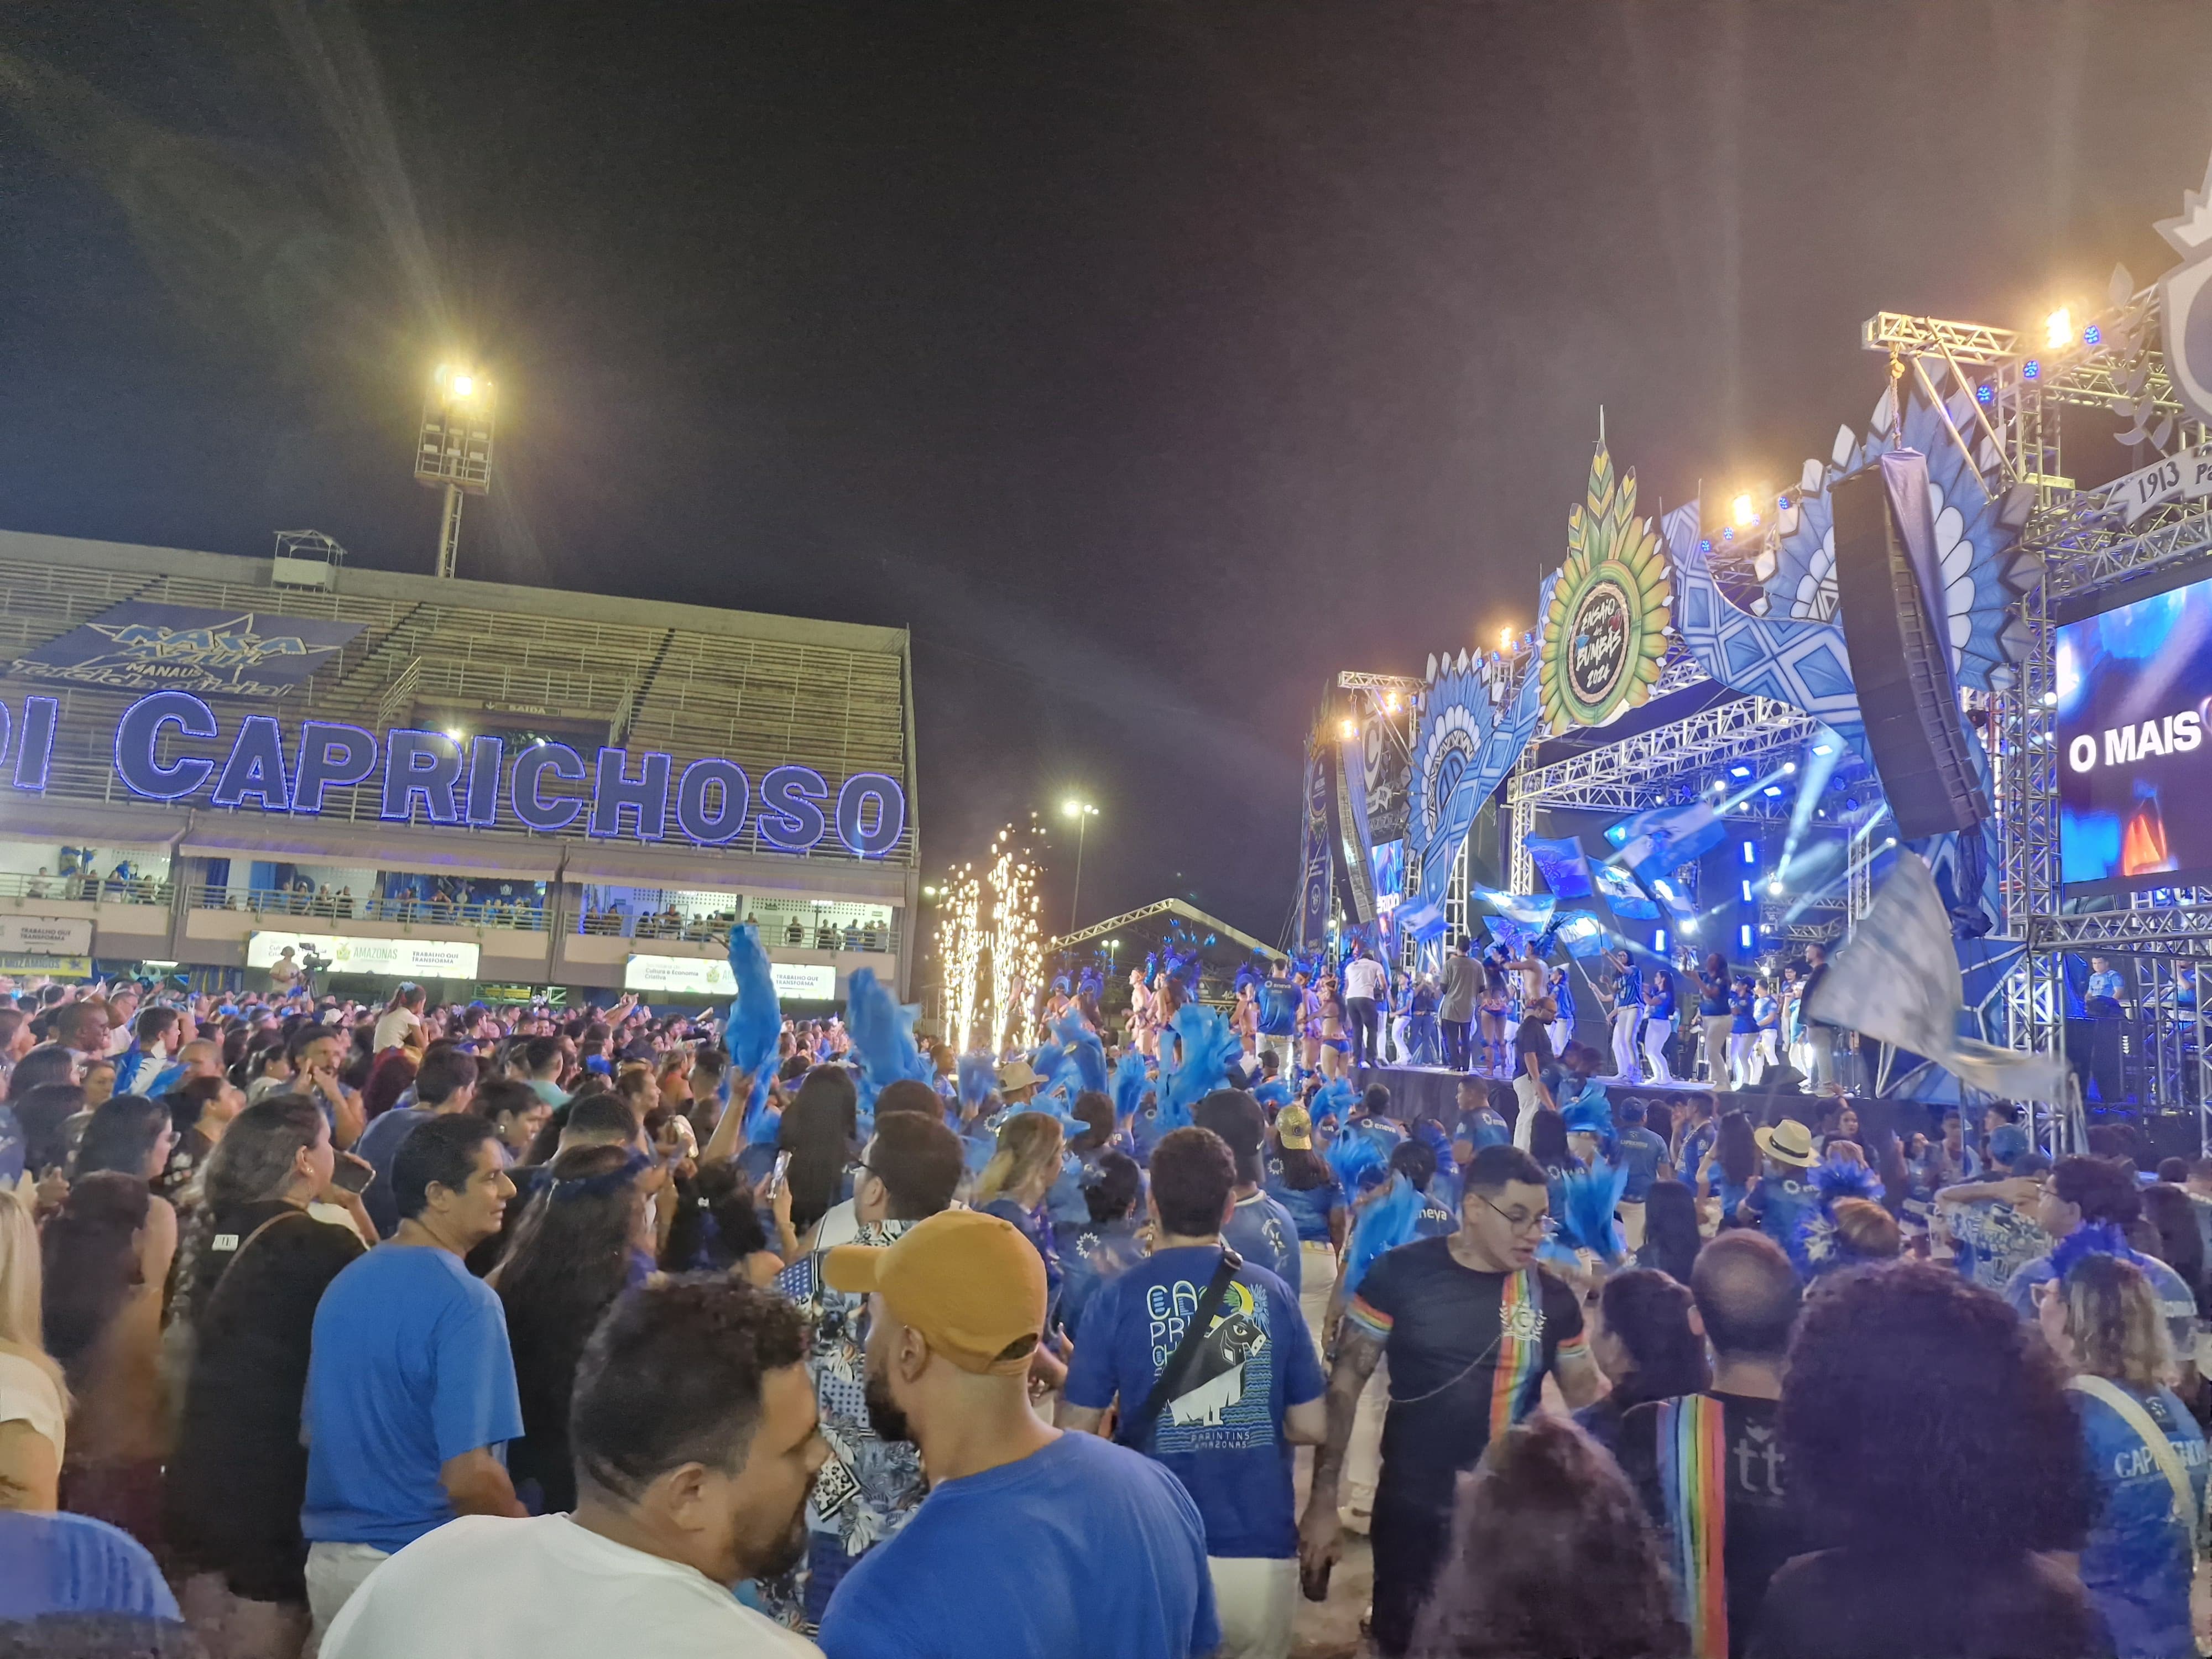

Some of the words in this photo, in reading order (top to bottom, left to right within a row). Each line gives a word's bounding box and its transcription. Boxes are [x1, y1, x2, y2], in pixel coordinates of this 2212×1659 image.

[2138, 461, 2180, 504] 1913
[126, 663, 202, 678] MANAUS
[1587, 664, 1610, 688] 2024
[2069, 734, 2096, 773] O
[2104, 711, 2202, 766] MAIS
[114, 690, 906, 855] CAPRICHOSO
[353, 946, 398, 959] AMAZONAS
[1375, 1123, 1396, 1133] eneva
[1418, 1208, 1447, 1222] neva
[1191, 1431, 1251, 1443] PARINTINS
